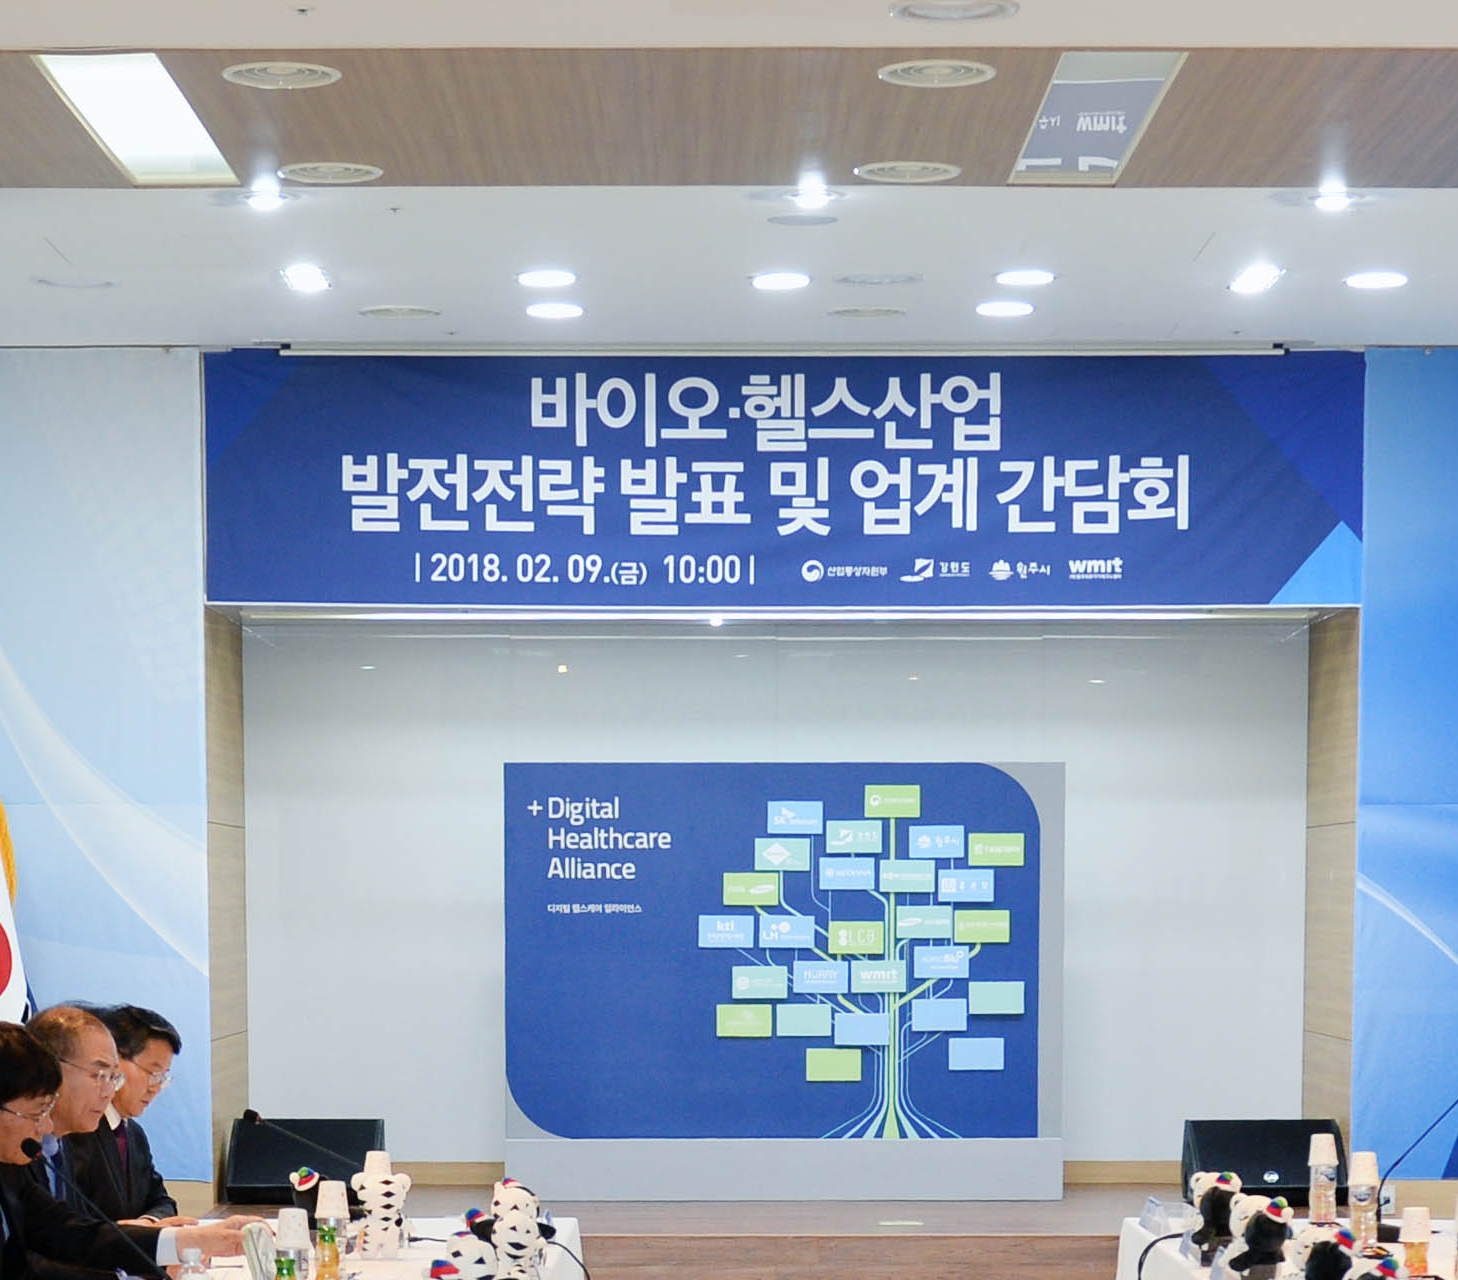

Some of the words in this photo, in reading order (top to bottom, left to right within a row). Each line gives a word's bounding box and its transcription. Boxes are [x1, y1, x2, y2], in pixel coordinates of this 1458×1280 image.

[529, 372, 1003, 451] 바이오·헬스산업
[341, 452, 606, 536] 발전전략
[620, 456, 752, 536] 발표
[769, 456, 831, 536] 및
[849, 455, 979, 536] 업계
[996, 453, 1190, 536] 간담회
[430, 552, 508, 582] 2018.
[516, 553, 559, 583] 02.
[663, 554, 741, 584] 10:00
[826, 563, 889, 579] 산업통상자원부
[939, 561, 970, 573] 강원도
[1016, 562, 1051, 580] 원주시
[1068, 557, 1123, 574] wmit
[547, 796, 620, 826] Digital
[547, 826, 672, 850] Healthcare
[547, 856, 636, 880] Alliance
